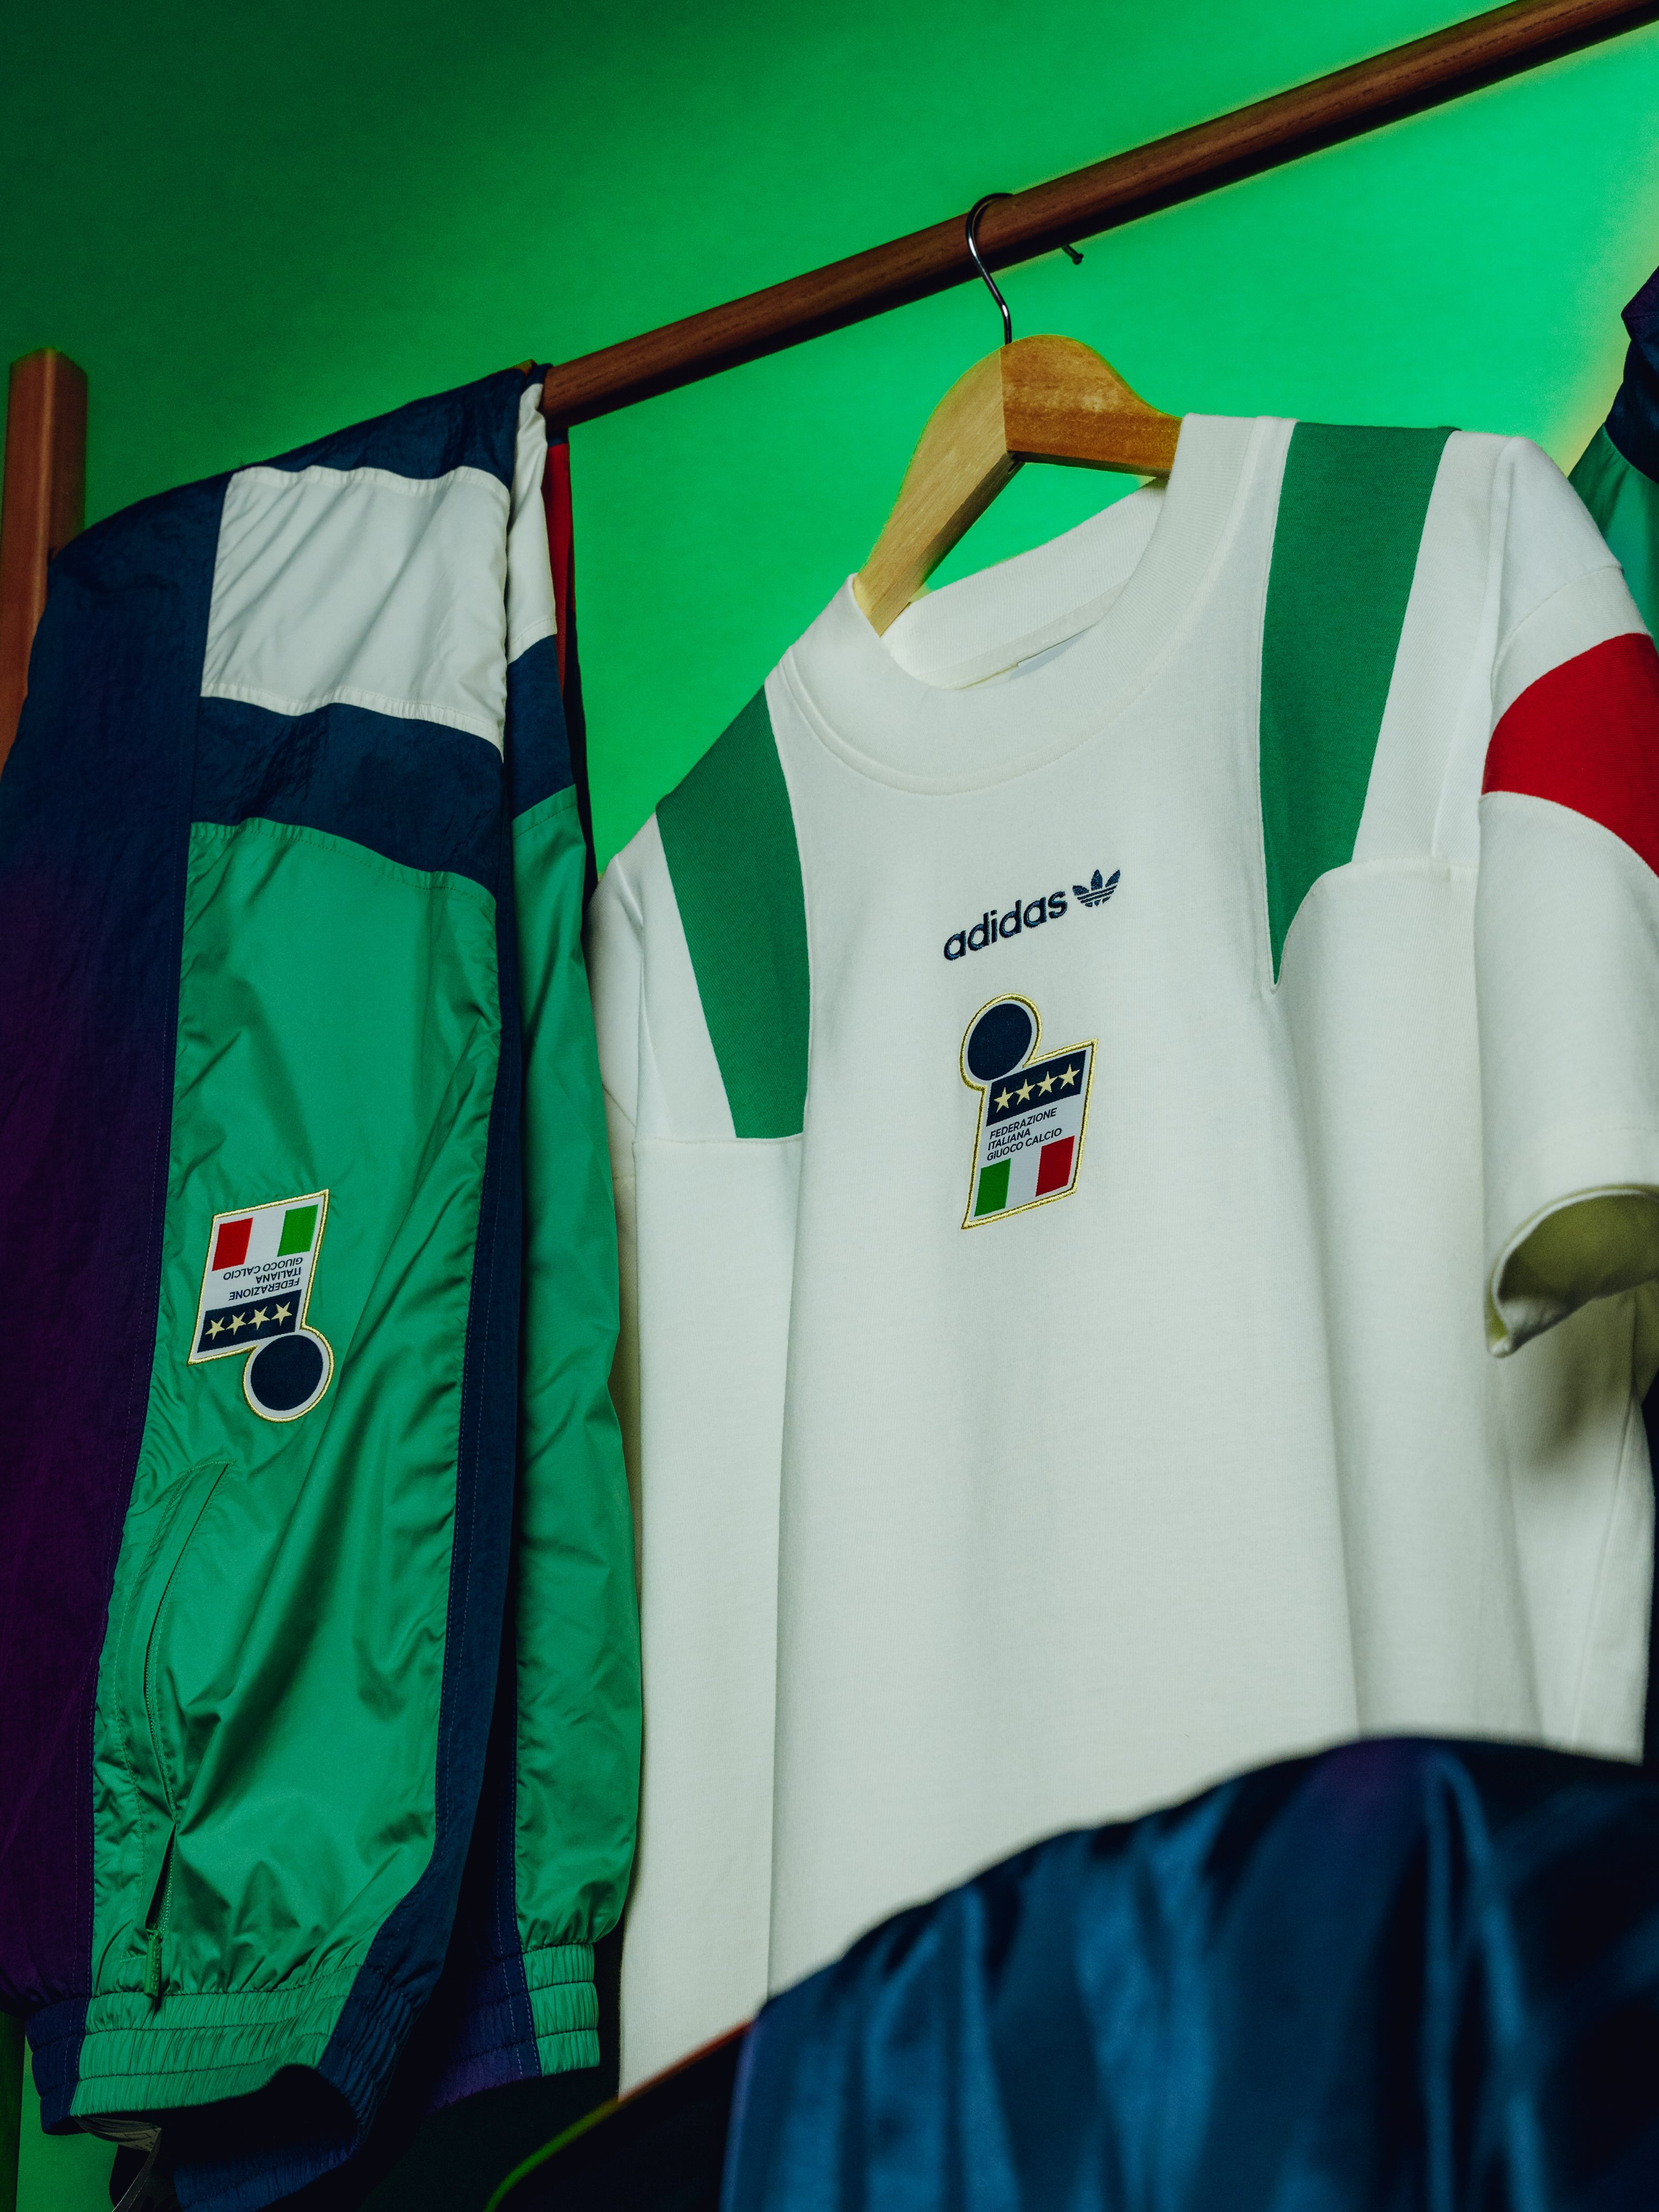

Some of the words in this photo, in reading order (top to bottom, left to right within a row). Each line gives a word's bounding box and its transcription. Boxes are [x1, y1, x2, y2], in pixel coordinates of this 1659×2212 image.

[944, 891, 1068, 961] adidas
[989, 1108, 1057, 1139] FEDERAZIONE
[987, 1141, 1023, 1161] GIUOCO
[1026, 1128, 1062, 1147] CALCIO
[988, 1128, 1030, 1150] ITALIANA
[223, 1266, 261, 1280] CALCIO
[256, 1267, 301, 1284] ITALIANA
[263, 1257, 303, 1272] GIUOCO
[229, 1278, 300, 1301] FEDERAZIONE
